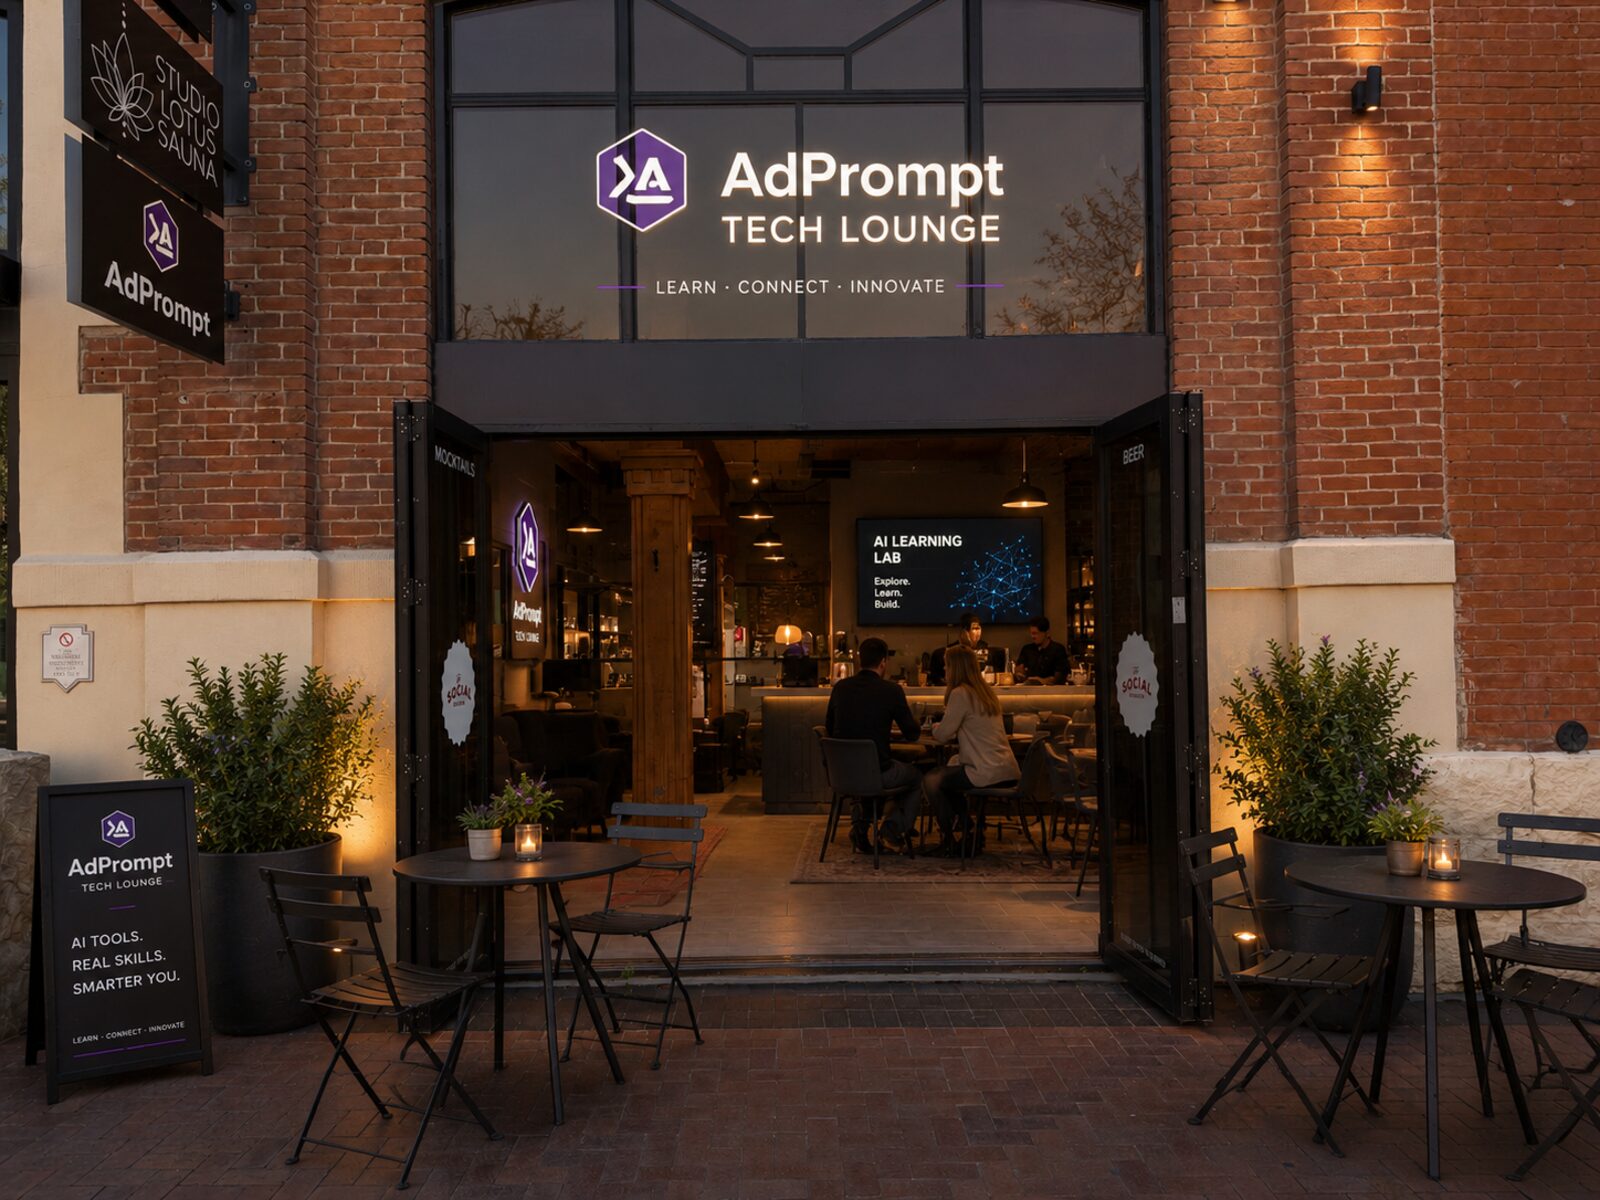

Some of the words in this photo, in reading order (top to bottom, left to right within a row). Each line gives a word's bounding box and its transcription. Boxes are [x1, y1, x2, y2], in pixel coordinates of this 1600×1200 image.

[156, 55, 220, 129] STUDIO
[161, 89, 216, 155] LOTUS
[158, 120, 218, 188] SAUNA
[720, 151, 1005, 208] AdPrompt
[721, 215, 823, 244] TECH
[841, 214, 1001, 243] LOUNGE
[655, 280, 717, 296] LEARN
[738, 279, 829, 295] CONNECT
[850, 278, 945, 294] INNOVATE
[104, 261, 211, 337] AdPrompt
[1123, 443, 1145, 465] BEER
[873, 535, 888, 547] AI
[892, 535, 963, 547] LEARNING
[874, 552, 902, 564] LAB
[874, 577, 911, 588] Explore.
[874, 588, 903, 598] Learn.
[874, 600, 901, 609] Build.
[446, 684, 472, 704] SOCIAL
[1122, 676, 1152, 697] SOCIAL
[68, 852, 174, 877] AdPrompt
[81, 881, 113, 893] TECH
[116, 876, 163, 890] LOUNGE
[71, 936, 86, 949] AI
[90, 930, 144, 947] TOOLS.
[72, 957, 111, 972] REAL
[115, 949, 167, 967] SKILLS.
[73, 975, 143, 995] SMARTER
[147, 970, 181, 984] YOU.
[72, 1034, 99, 1045] LEARN
[105, 1027, 142, 1040] CONNECT
[148, 1020, 186, 1033] INNOVATE
